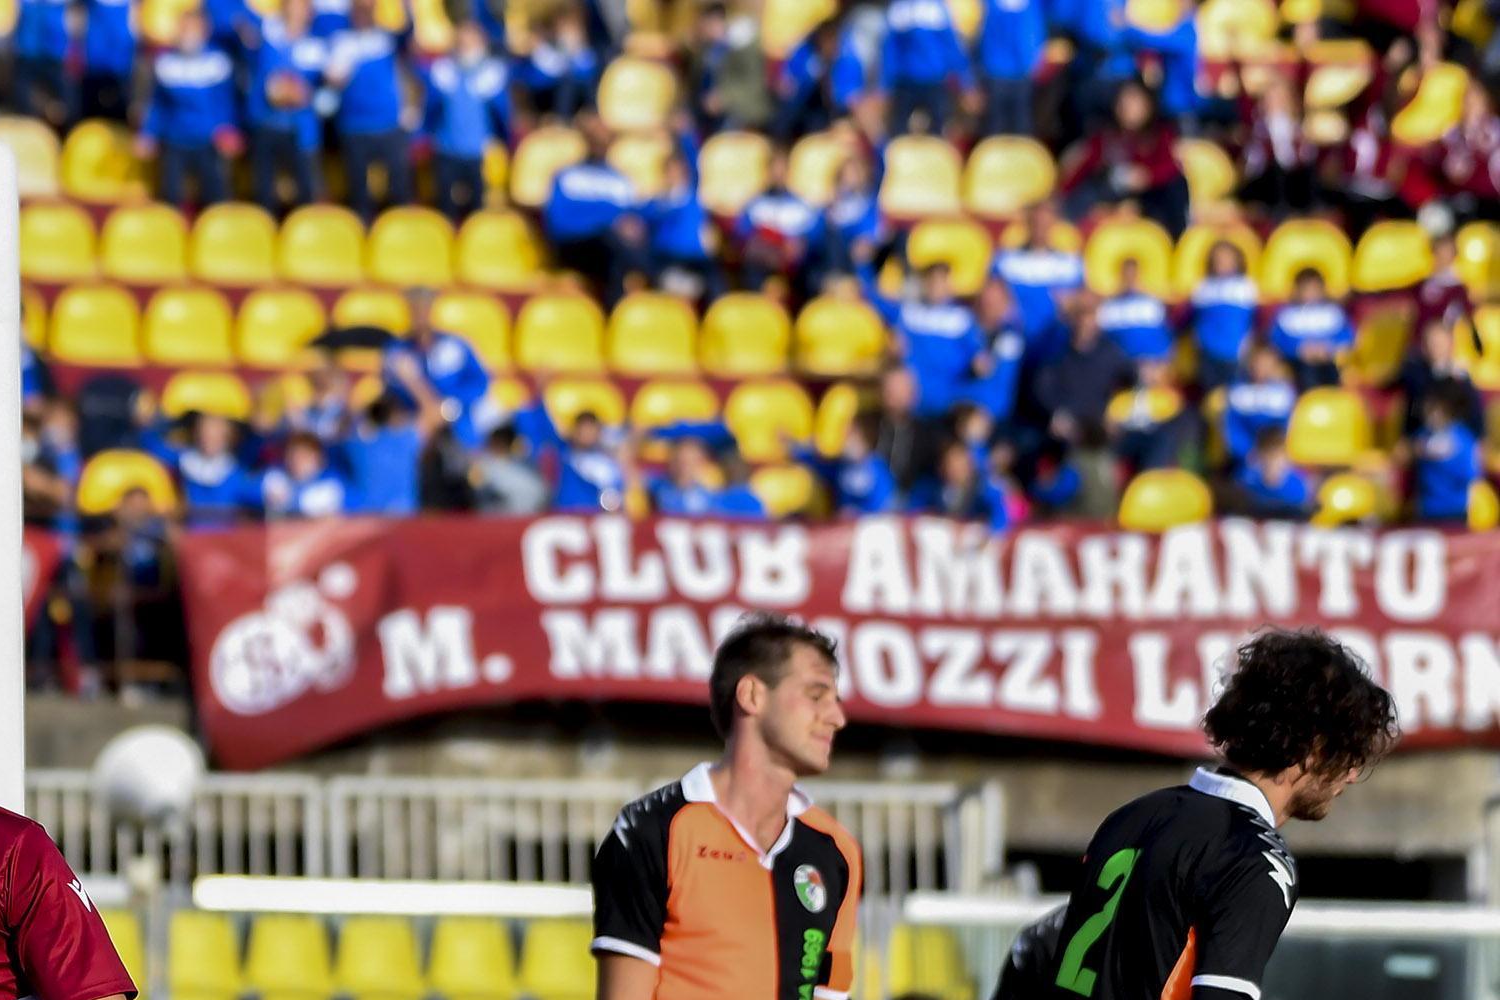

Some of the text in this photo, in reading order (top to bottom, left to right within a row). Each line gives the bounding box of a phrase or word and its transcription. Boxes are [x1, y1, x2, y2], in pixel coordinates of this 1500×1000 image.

[521, 516, 811, 606] CLUB
[379, 605, 515, 699] M.
[1054, 847, 1142, 999] 2
